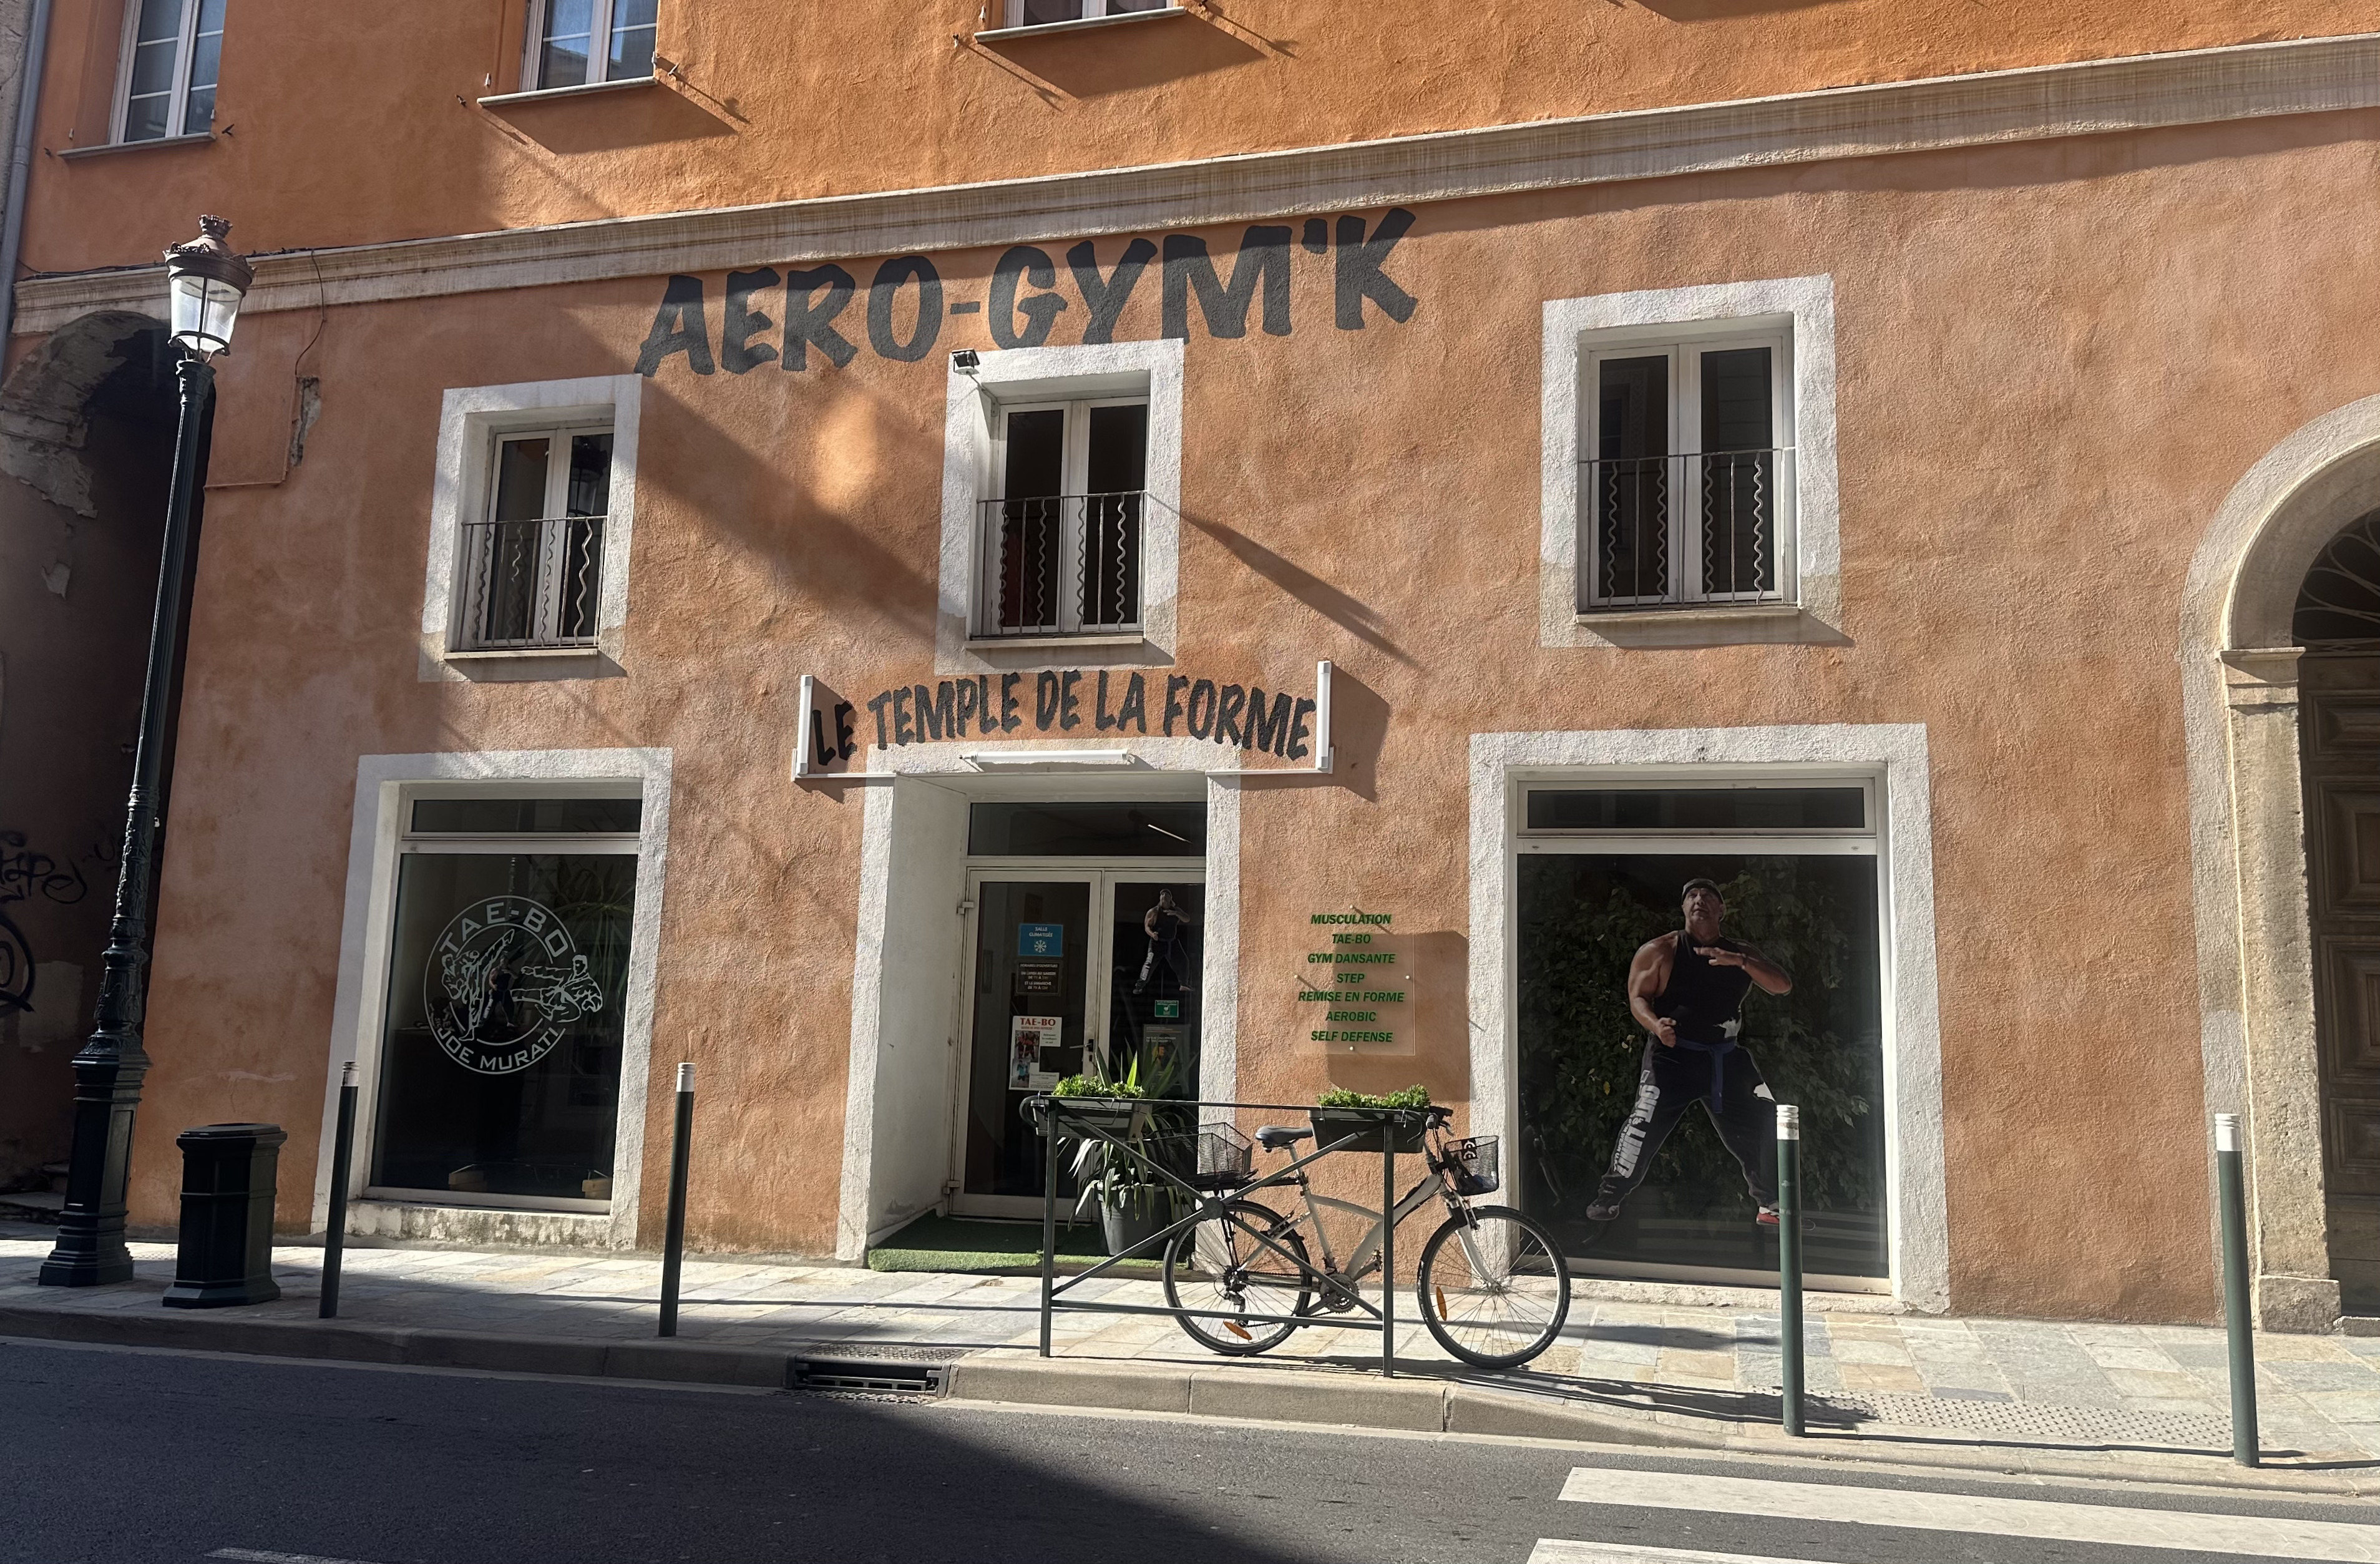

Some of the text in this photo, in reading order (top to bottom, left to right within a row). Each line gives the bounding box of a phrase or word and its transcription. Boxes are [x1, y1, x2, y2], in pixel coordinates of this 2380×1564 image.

[634, 208, 1418, 377] AERO-GYM'K
[811, 669, 1316, 767] LE TEMPLE DE LA FORME
[1310, 914, 1392, 924] MUSCULATION
[439, 902, 568, 958] TAE-BO
[1332, 934, 1372, 944] TAE-BO
[1307, 953, 1396, 964] GYM DANSANTE
[1337, 973, 1365, 984] STEP
[1298, 991, 1405, 1002] REMISE EN FORME
[1020, 1018, 1056, 1026] TAE-BO
[1325, 1011, 1377, 1022] AEROBIC
[1311, 1030, 1393, 1042] SELF DEFENSE
[437, 1027, 559, 1071] JOE MURATI
